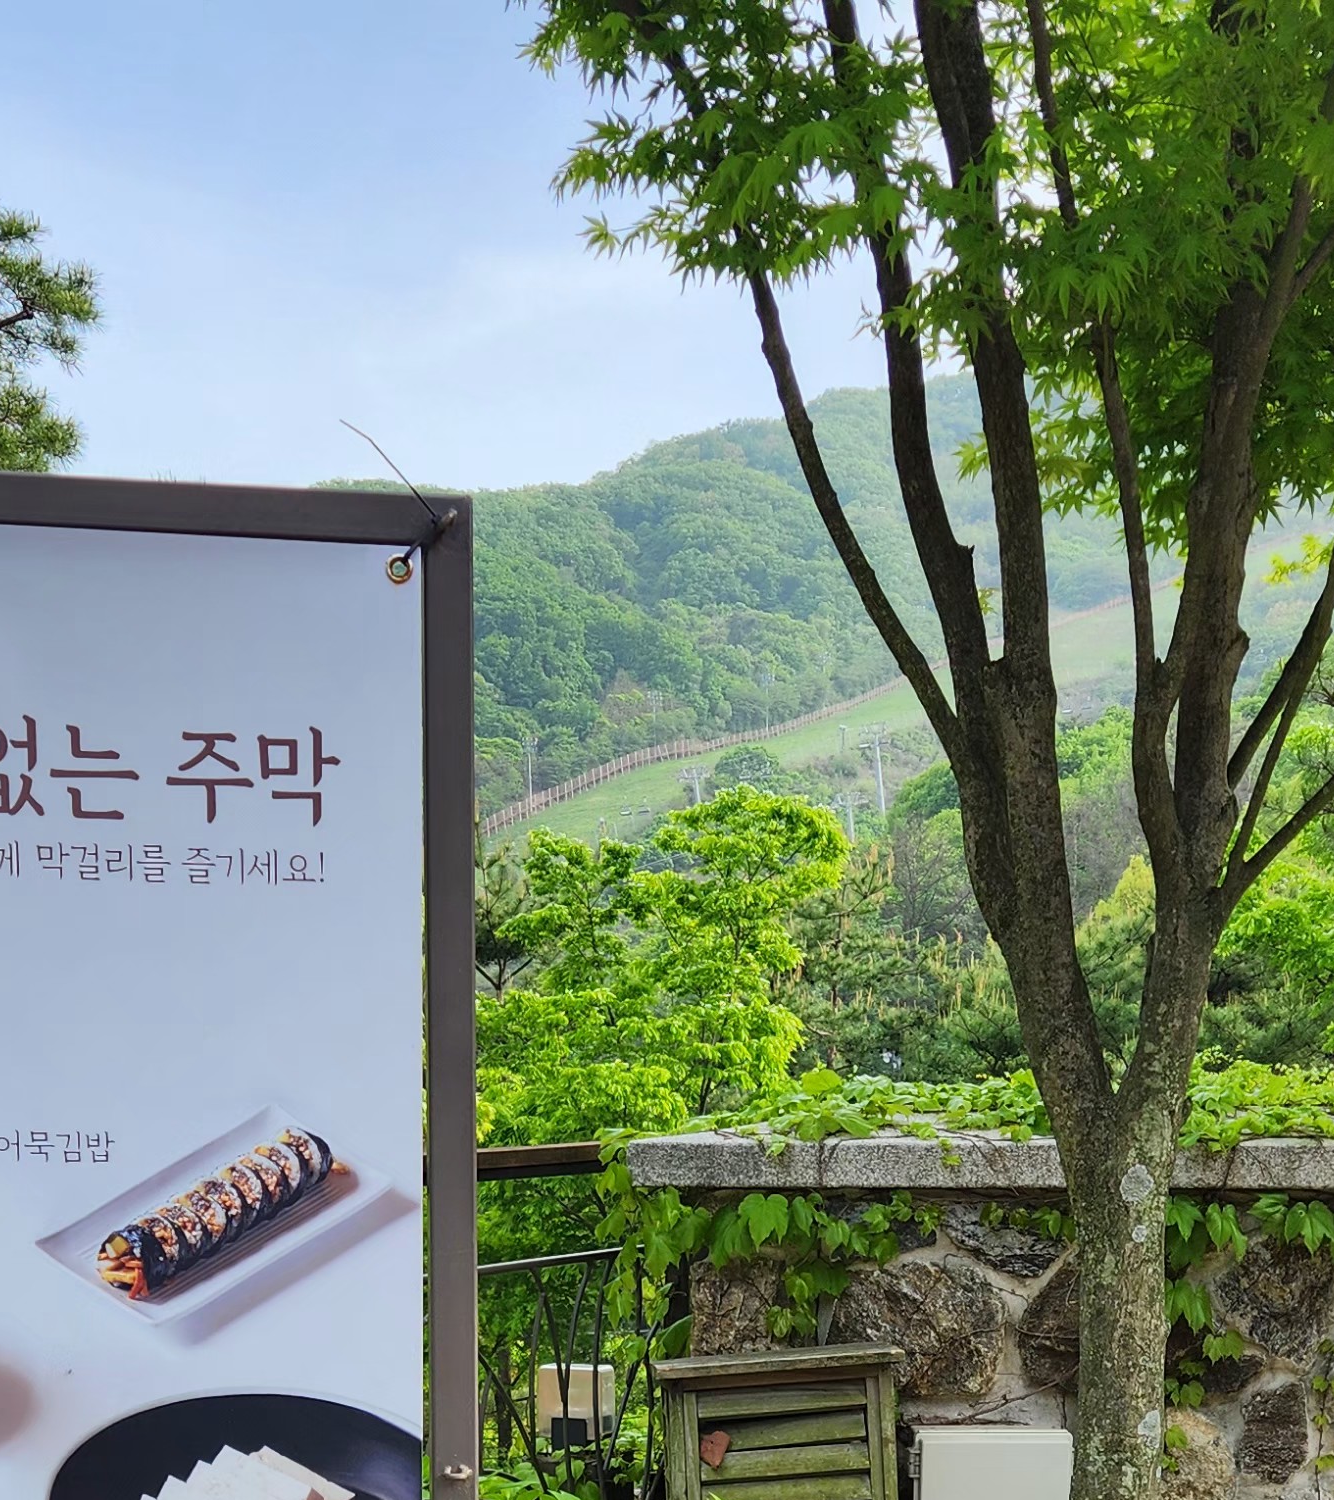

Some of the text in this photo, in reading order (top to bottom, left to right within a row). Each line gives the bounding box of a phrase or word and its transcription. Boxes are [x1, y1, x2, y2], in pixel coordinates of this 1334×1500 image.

[165, 725, 342, 827] 주막
[36, 842, 172, 883] 막걸리를
[181, 847, 325, 886] 즐기세요!
